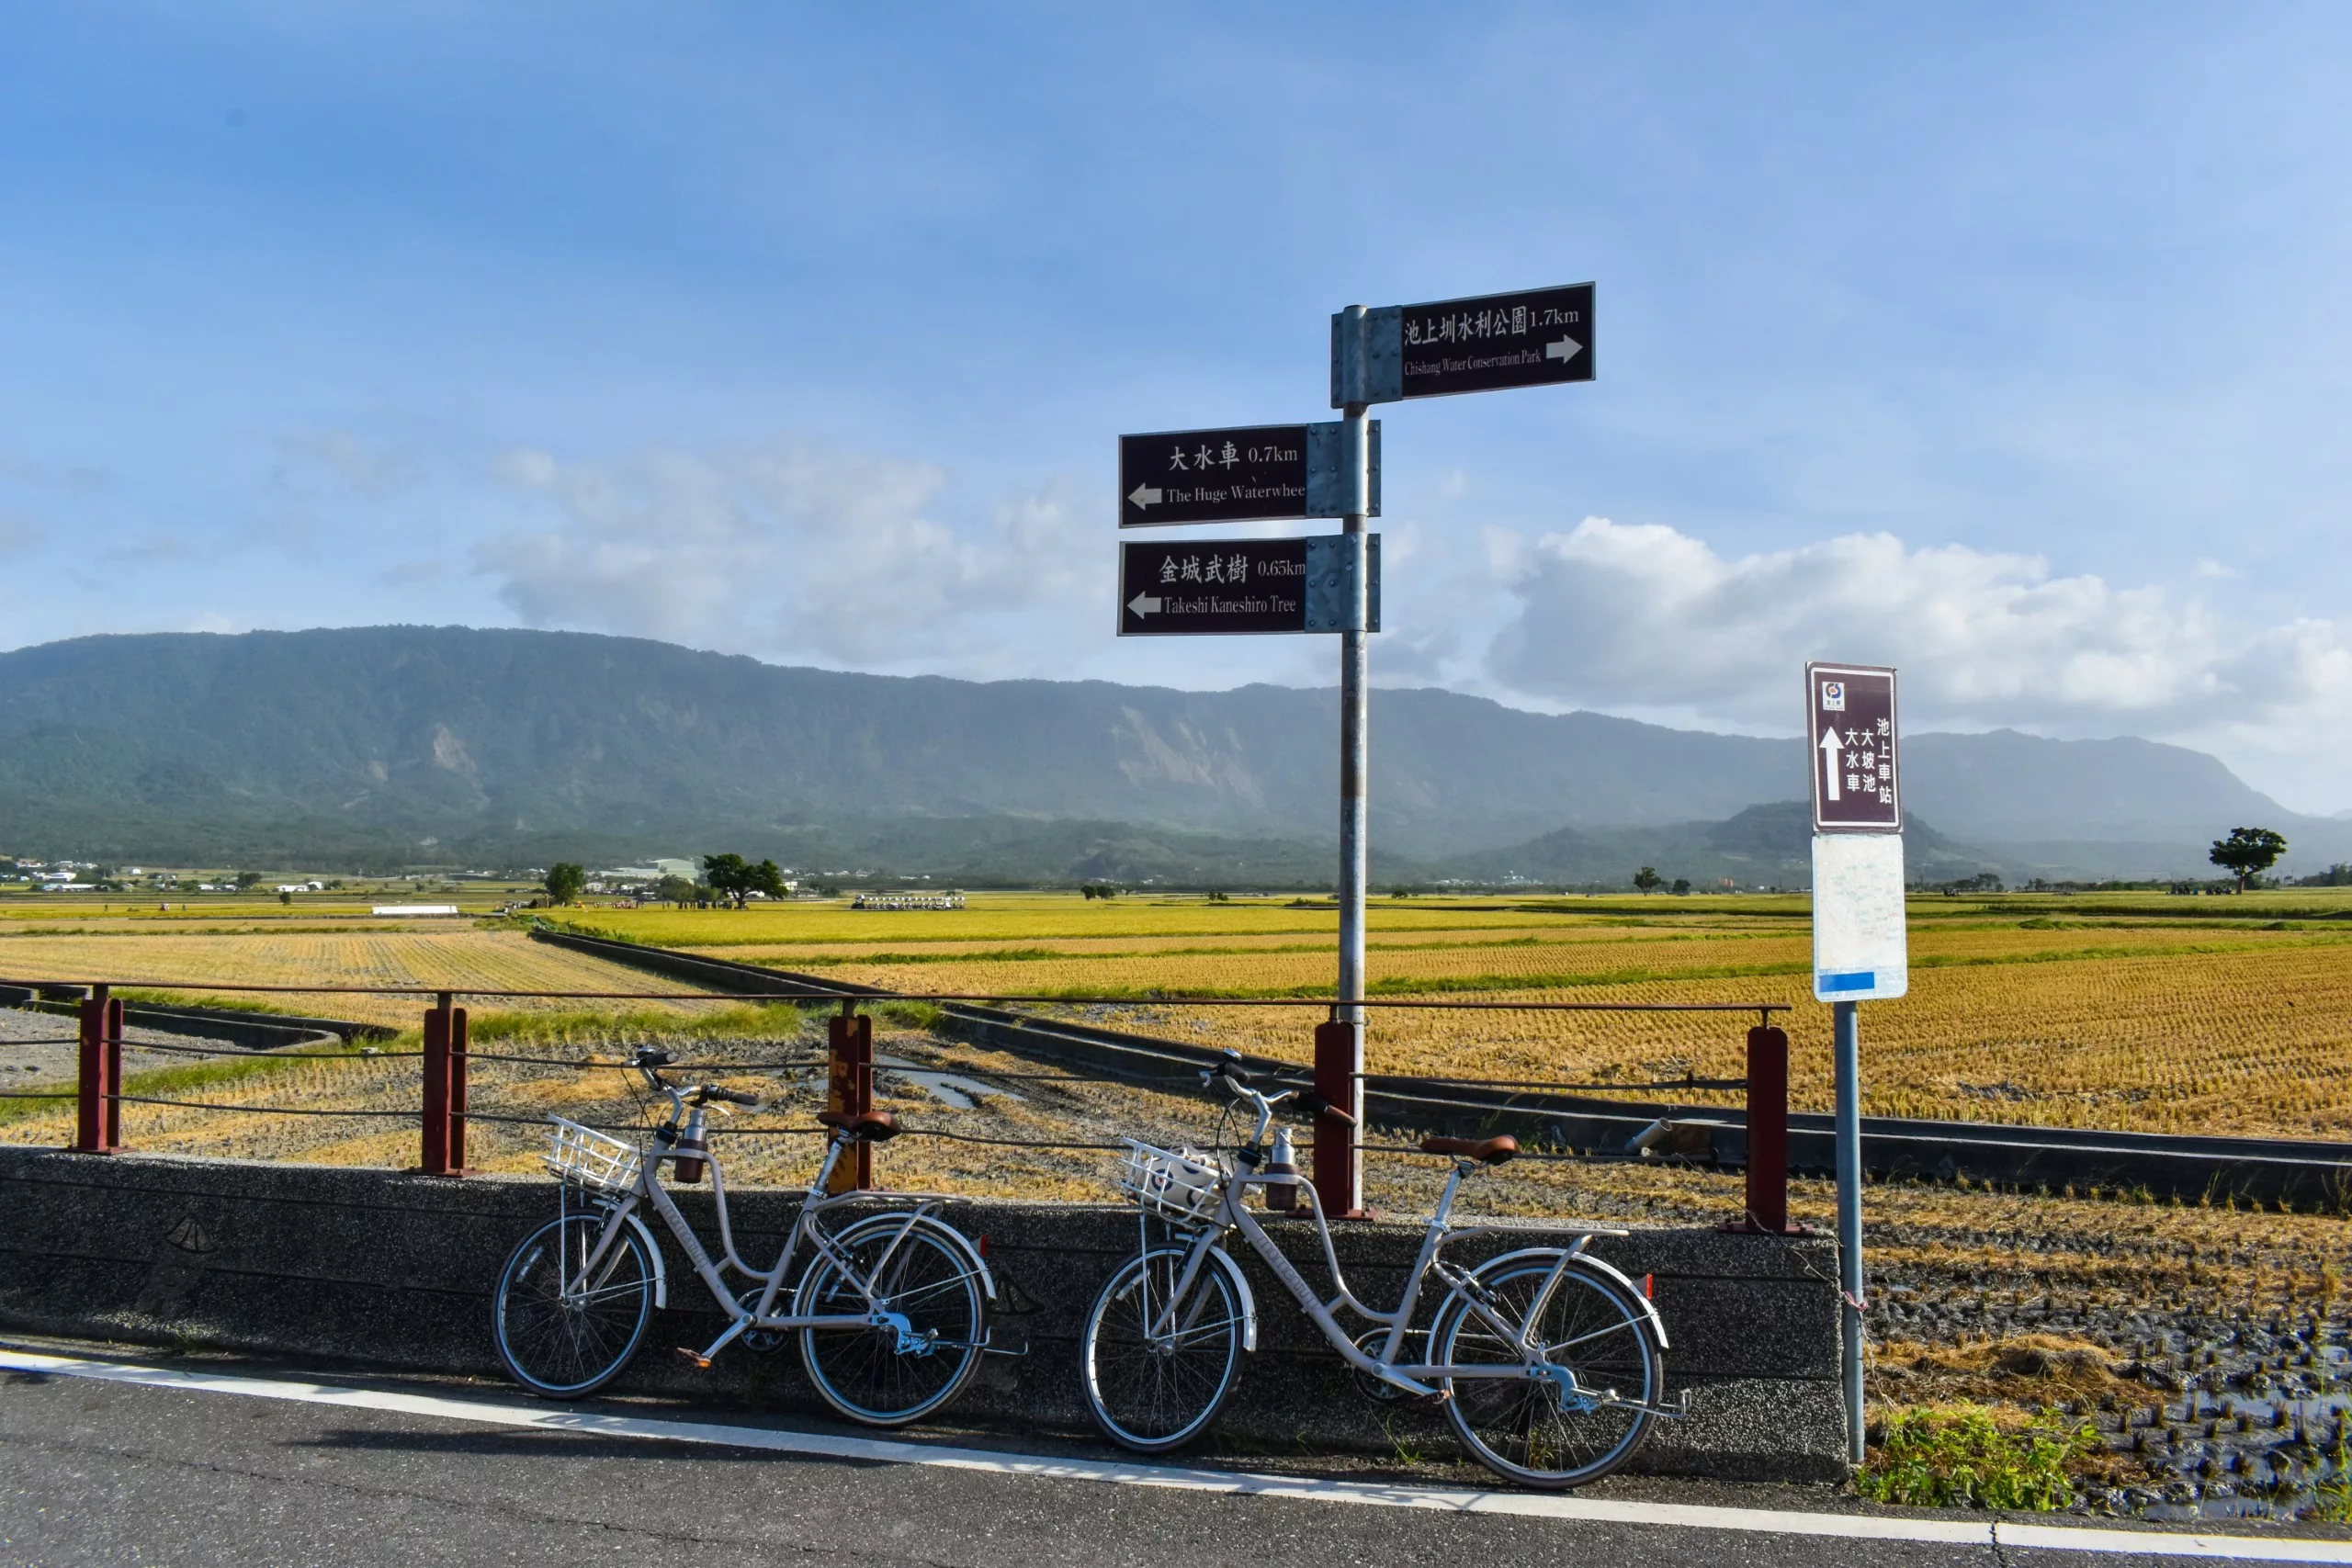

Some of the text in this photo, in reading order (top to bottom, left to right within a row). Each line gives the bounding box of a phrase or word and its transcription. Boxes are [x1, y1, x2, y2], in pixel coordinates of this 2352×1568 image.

[1404, 305, 1579, 346] 池上圳水利公園 1.7km
[1405, 349, 1541, 377] Chishang Water Conservation Park
[1169, 441, 1297, 471] 大水車 0.7km
[1167, 483, 1306, 503] The Huge Waterwhee
[1159, 554, 1306, 584] 金城武樹 0.65km
[1164, 595, 1296, 614] Takeshi Kaneshiro Tree
[1845, 727, 1860, 792] 大水車
[1861, 728, 1876, 793] 大坡池
[1876, 717, 1893, 805] 池上車站
